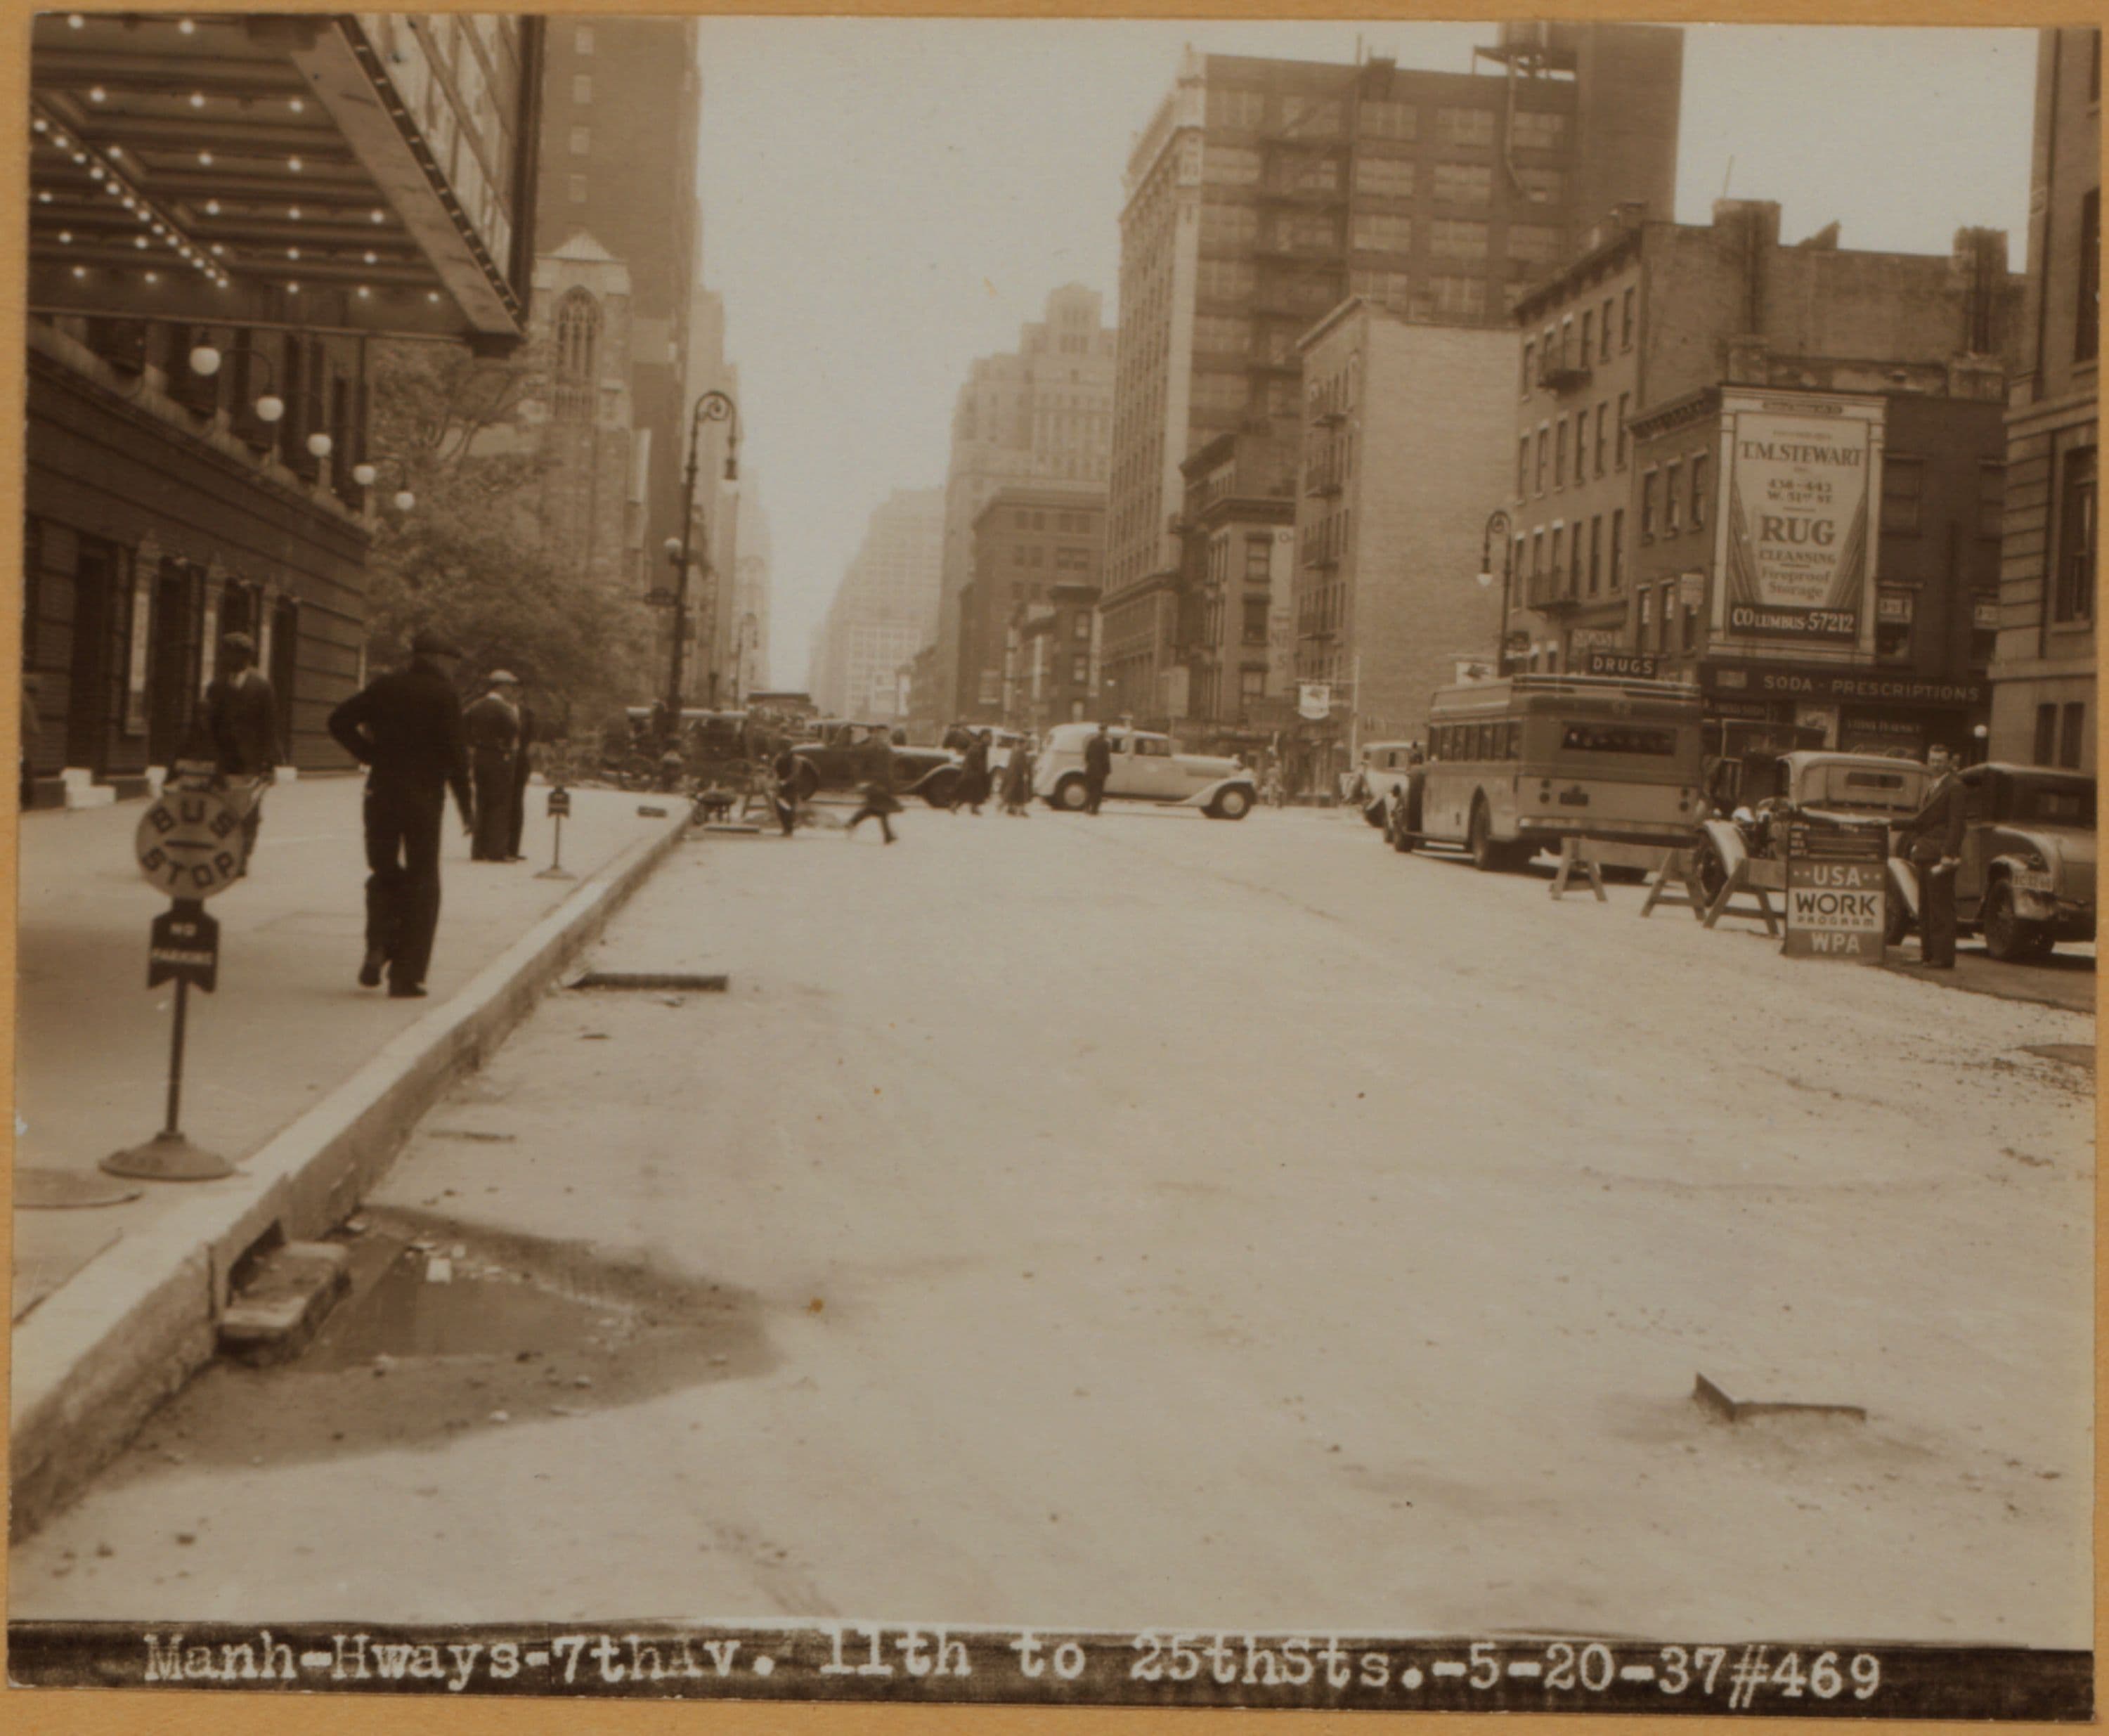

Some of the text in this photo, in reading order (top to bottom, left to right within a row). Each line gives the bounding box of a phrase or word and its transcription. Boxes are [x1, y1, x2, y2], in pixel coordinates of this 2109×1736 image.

[1760, 515, 1836, 546] RUG
[1759, 550, 1836, 565] CLEANSING
[1592, 656, 1654, 675] DRUGS
[1763, 675, 1980, 702] SODA PRESCRIPTIONS
[150, 798, 240, 838] BUS
[142, 847, 235, 890] STOP
[1813, 864, 1862, 887] USA
[1795, 893, 1876, 916] WORK
[1796, 916, 1875, 927] PROGRAM
[1811, 931, 1861, 954] WPA
